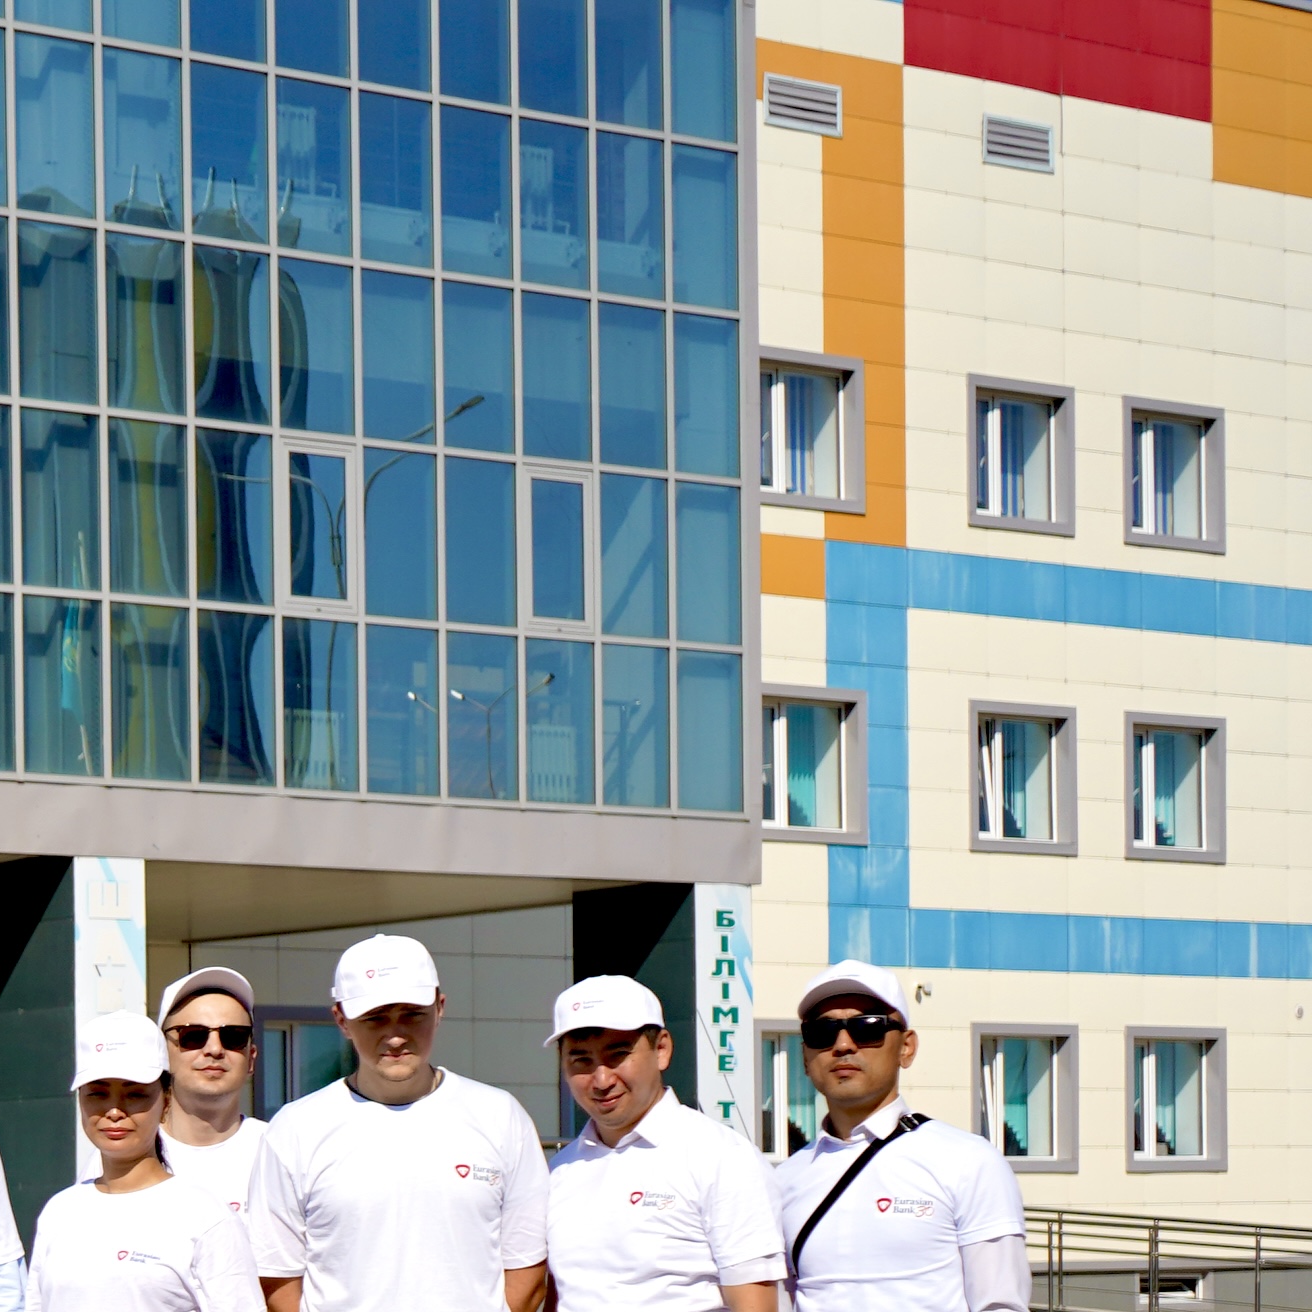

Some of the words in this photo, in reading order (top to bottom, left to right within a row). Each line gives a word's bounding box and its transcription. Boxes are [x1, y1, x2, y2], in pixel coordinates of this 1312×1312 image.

[711, 909, 740, 1072] БІЛІМГЕ
[893, 1197, 934, 1206] Eurasian
[893, 1205, 916, 1214] Bank
